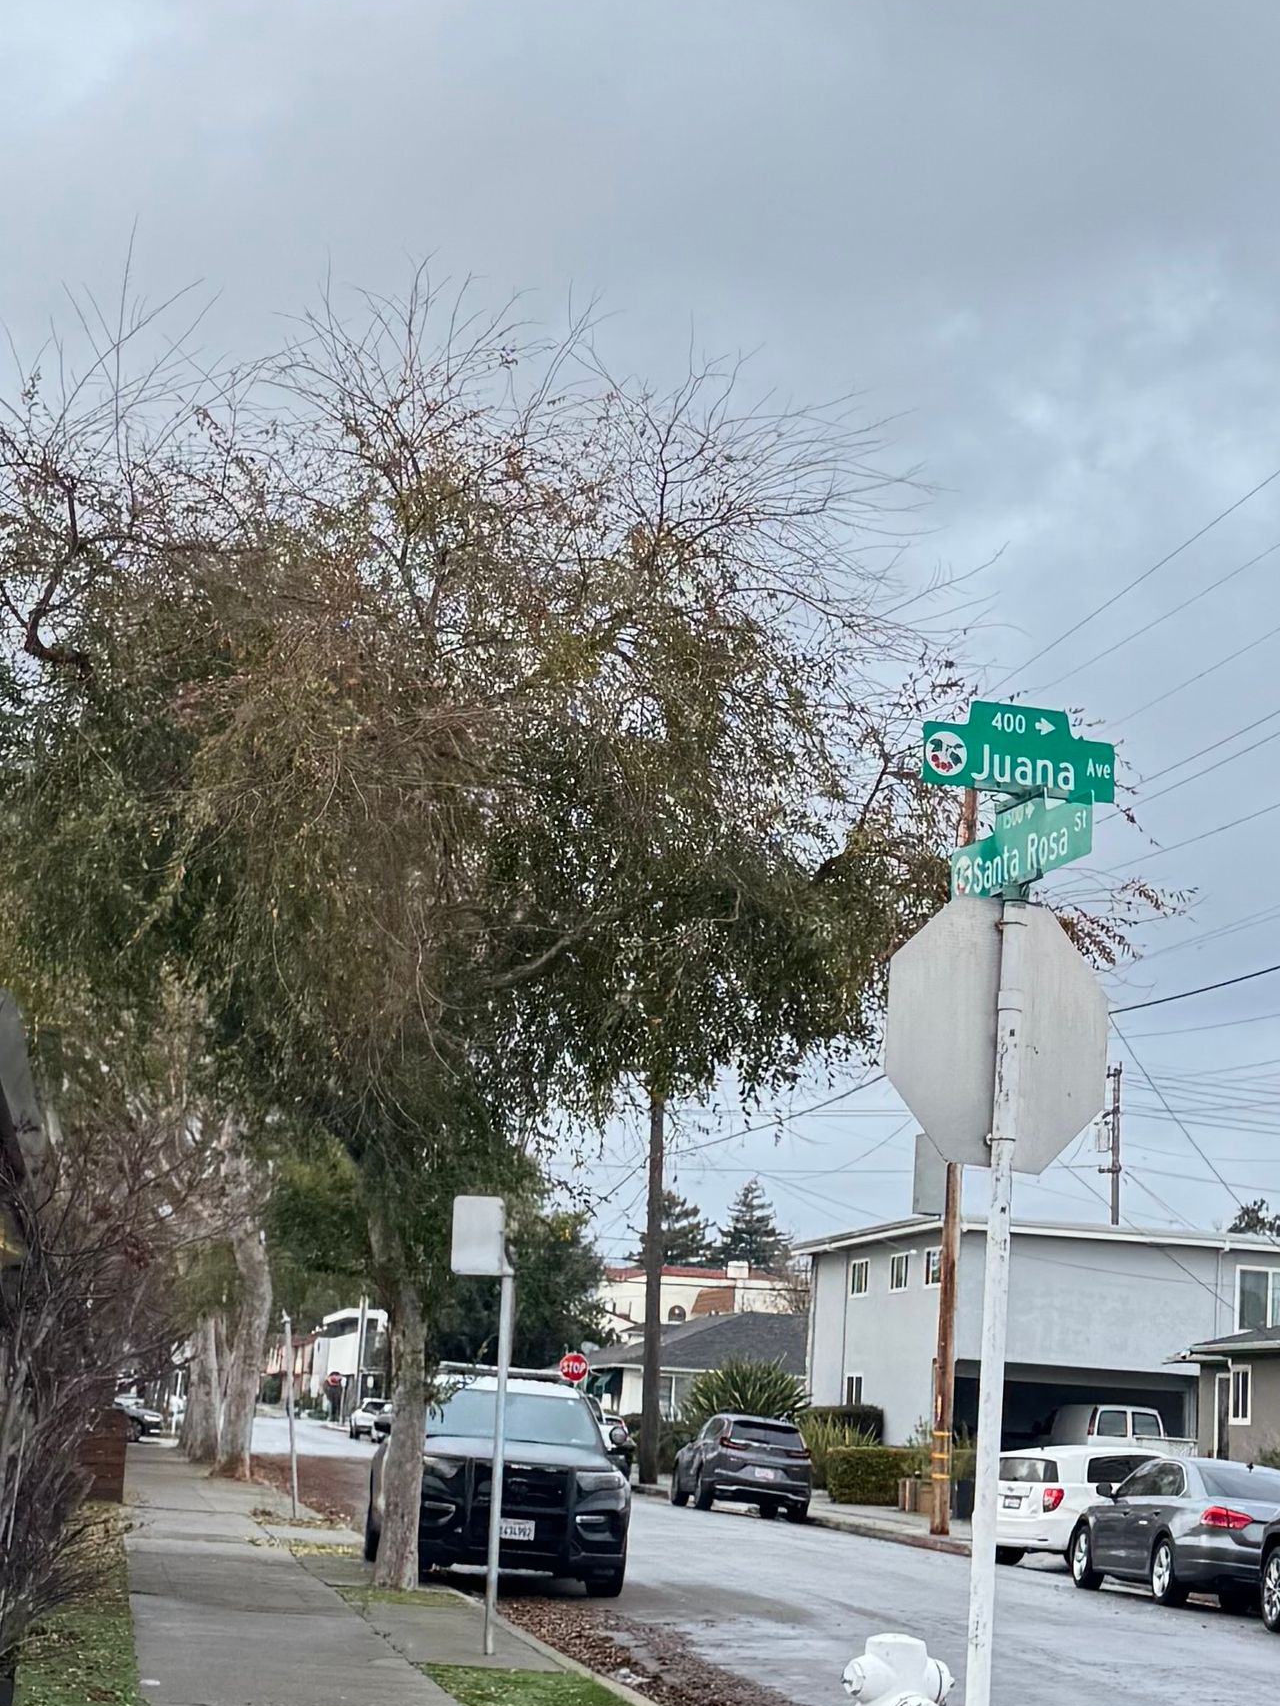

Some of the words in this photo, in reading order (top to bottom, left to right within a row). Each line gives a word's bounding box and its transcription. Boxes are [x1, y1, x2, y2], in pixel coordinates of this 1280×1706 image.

[991, 712, 1026, 734] 400
[970, 744, 1075, 791] Juana
[1086, 758, 1111, 779] Ave
[972, 845, 1020, 894] Santa
[1027, 827, 1068, 871] Rosa
[1073, 809, 1087, 832] St
[562, 1360, 586, 1374] STOP
